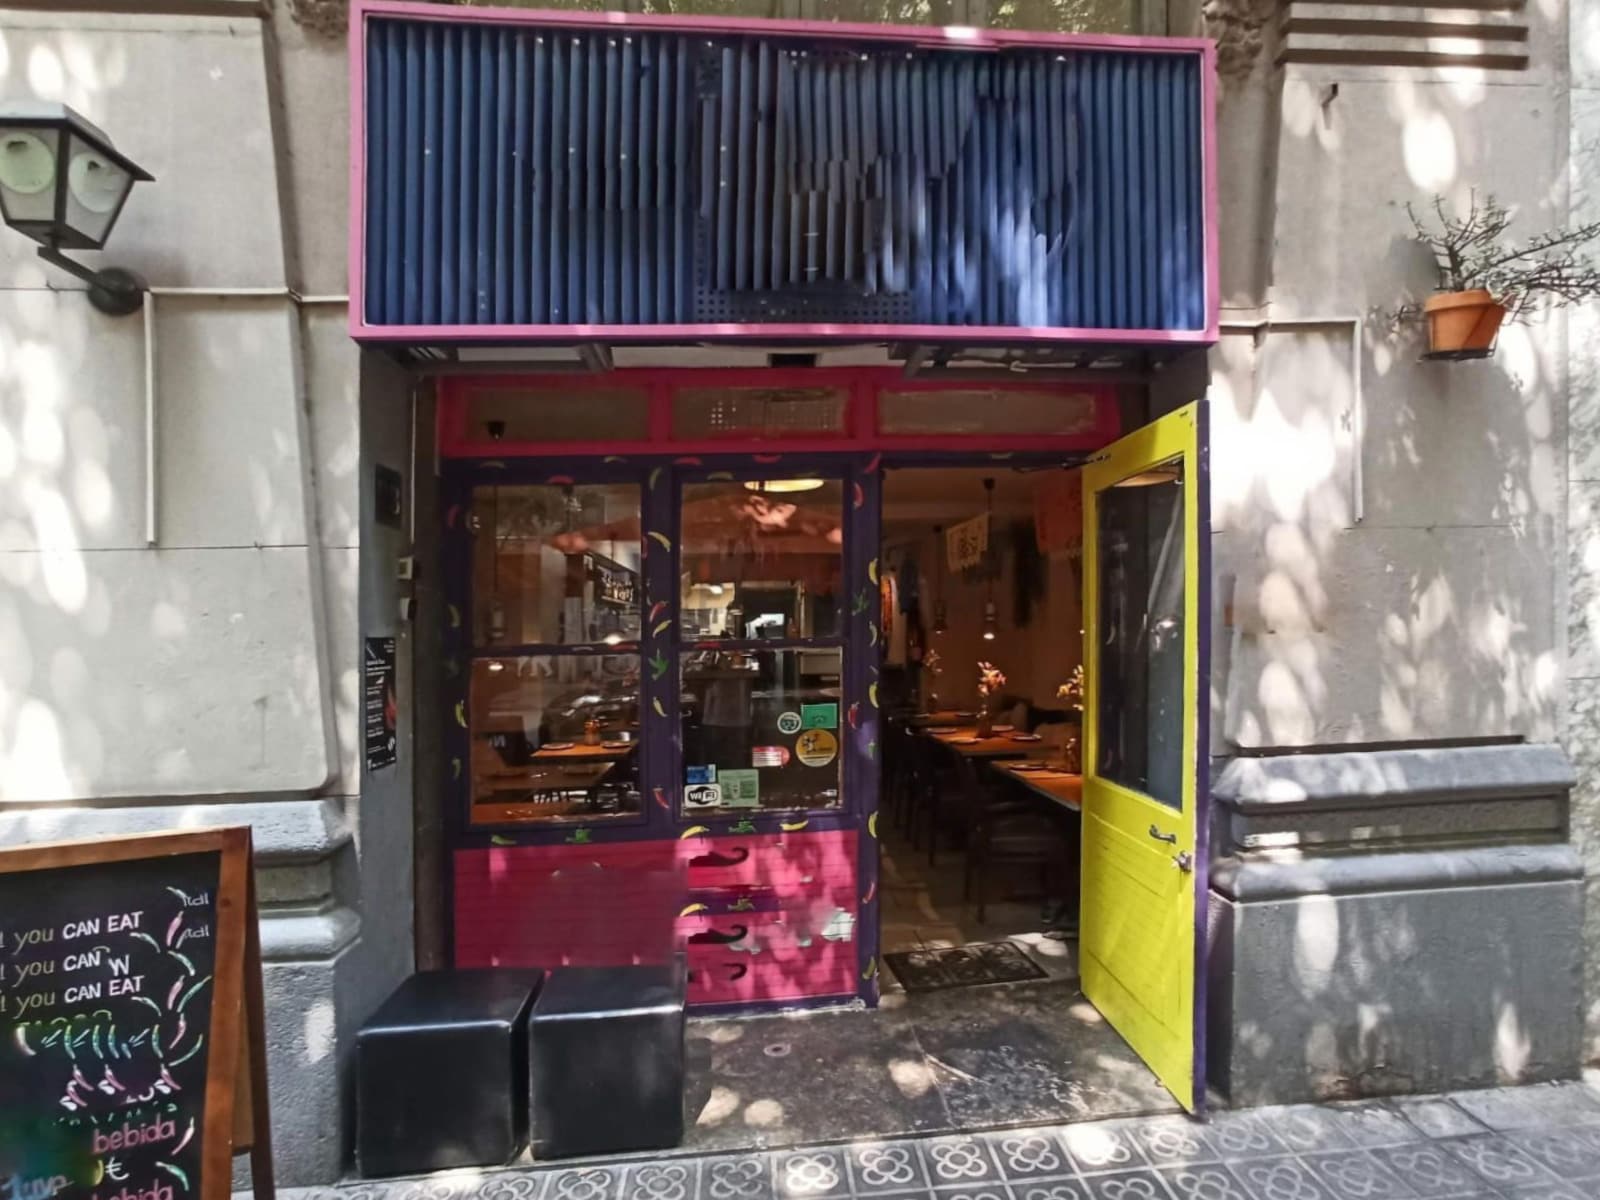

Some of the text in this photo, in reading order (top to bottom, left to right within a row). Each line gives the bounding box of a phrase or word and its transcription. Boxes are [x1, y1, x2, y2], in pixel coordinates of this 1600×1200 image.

[12, 928, 54, 956] you
[62, 918, 101, 940] CAN
[107, 910, 144, 933] EAT
[12, 959, 55, 988] you
[63, 950, 101, 972] CAN
[12, 991, 55, 1020] you
[64, 982, 101, 1004] CAN
[108, 974, 145, 997] EAT
[91, 1112, 175, 1155] bebida
